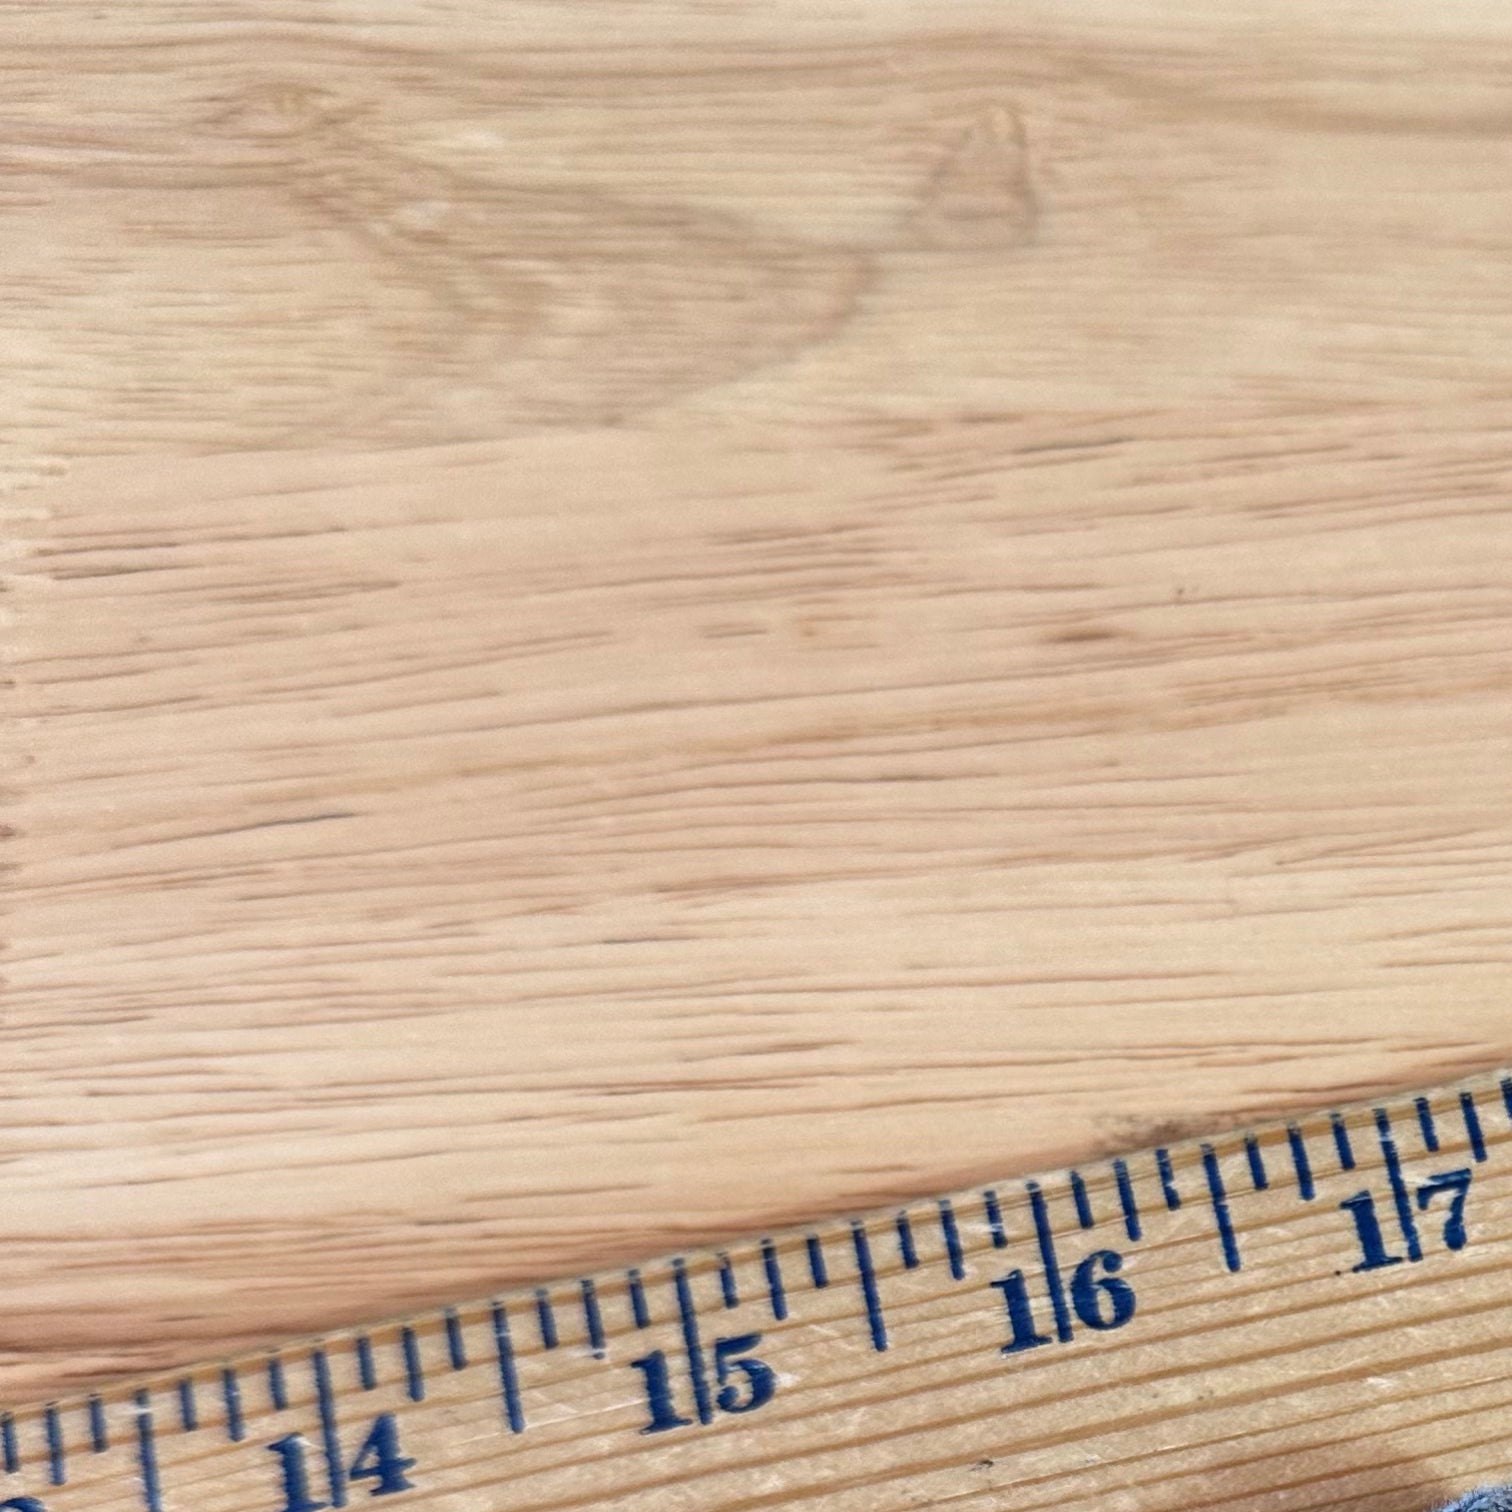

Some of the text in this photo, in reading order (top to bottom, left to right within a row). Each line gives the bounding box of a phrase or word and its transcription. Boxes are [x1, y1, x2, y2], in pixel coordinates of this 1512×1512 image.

[630, 1333, 777, 1434] 15
[991, 1250, 1137, 1354] 16
[1340, 1168, 1472, 1272] 17
